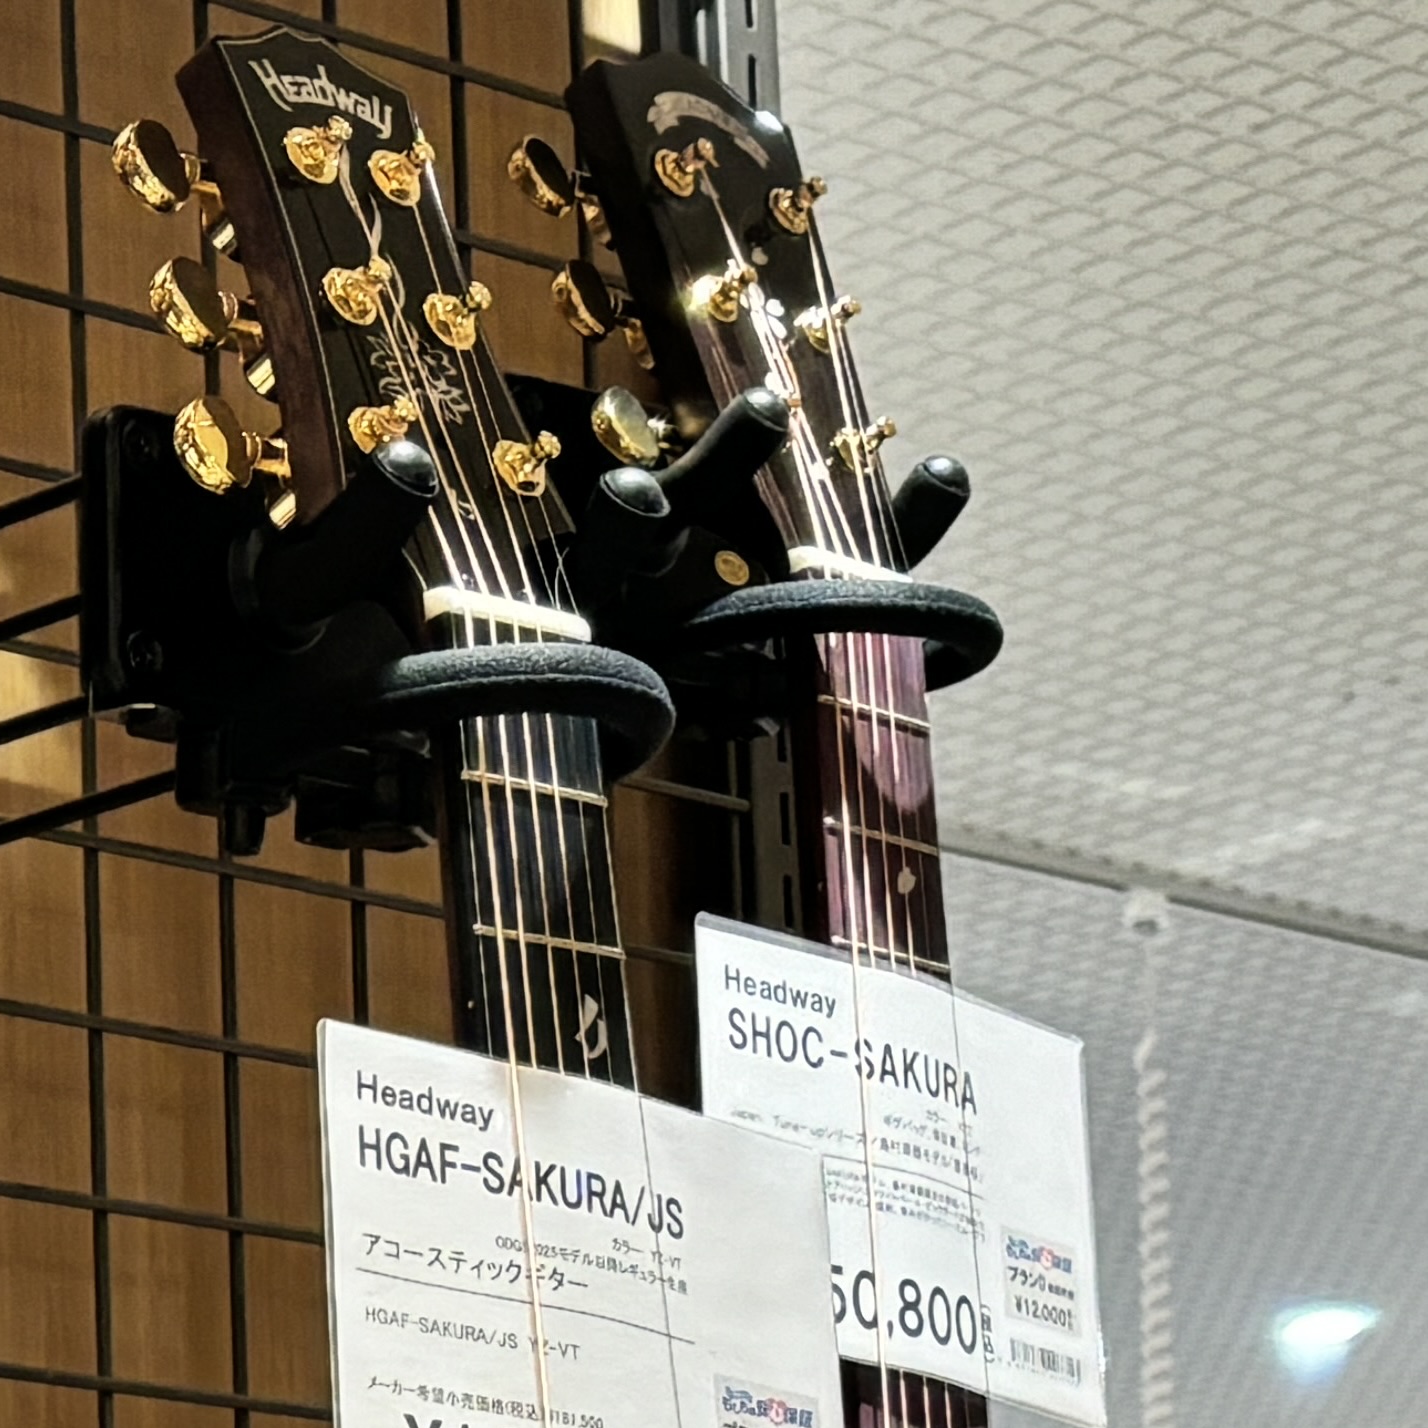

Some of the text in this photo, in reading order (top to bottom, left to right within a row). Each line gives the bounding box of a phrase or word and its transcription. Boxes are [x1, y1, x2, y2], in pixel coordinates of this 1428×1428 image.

[724, 965, 837, 1018] Headway
[727, 1009, 978, 1114] SHOC-SAKURA
[356, 1071, 496, 1132] Headway
[358, 1124, 685, 1241] HGAF-SAKURA/JS
[362, 1233, 589, 1291] アコースティックギター
[366, 1307, 519, 1350] HGAF-SAKURA/JS
